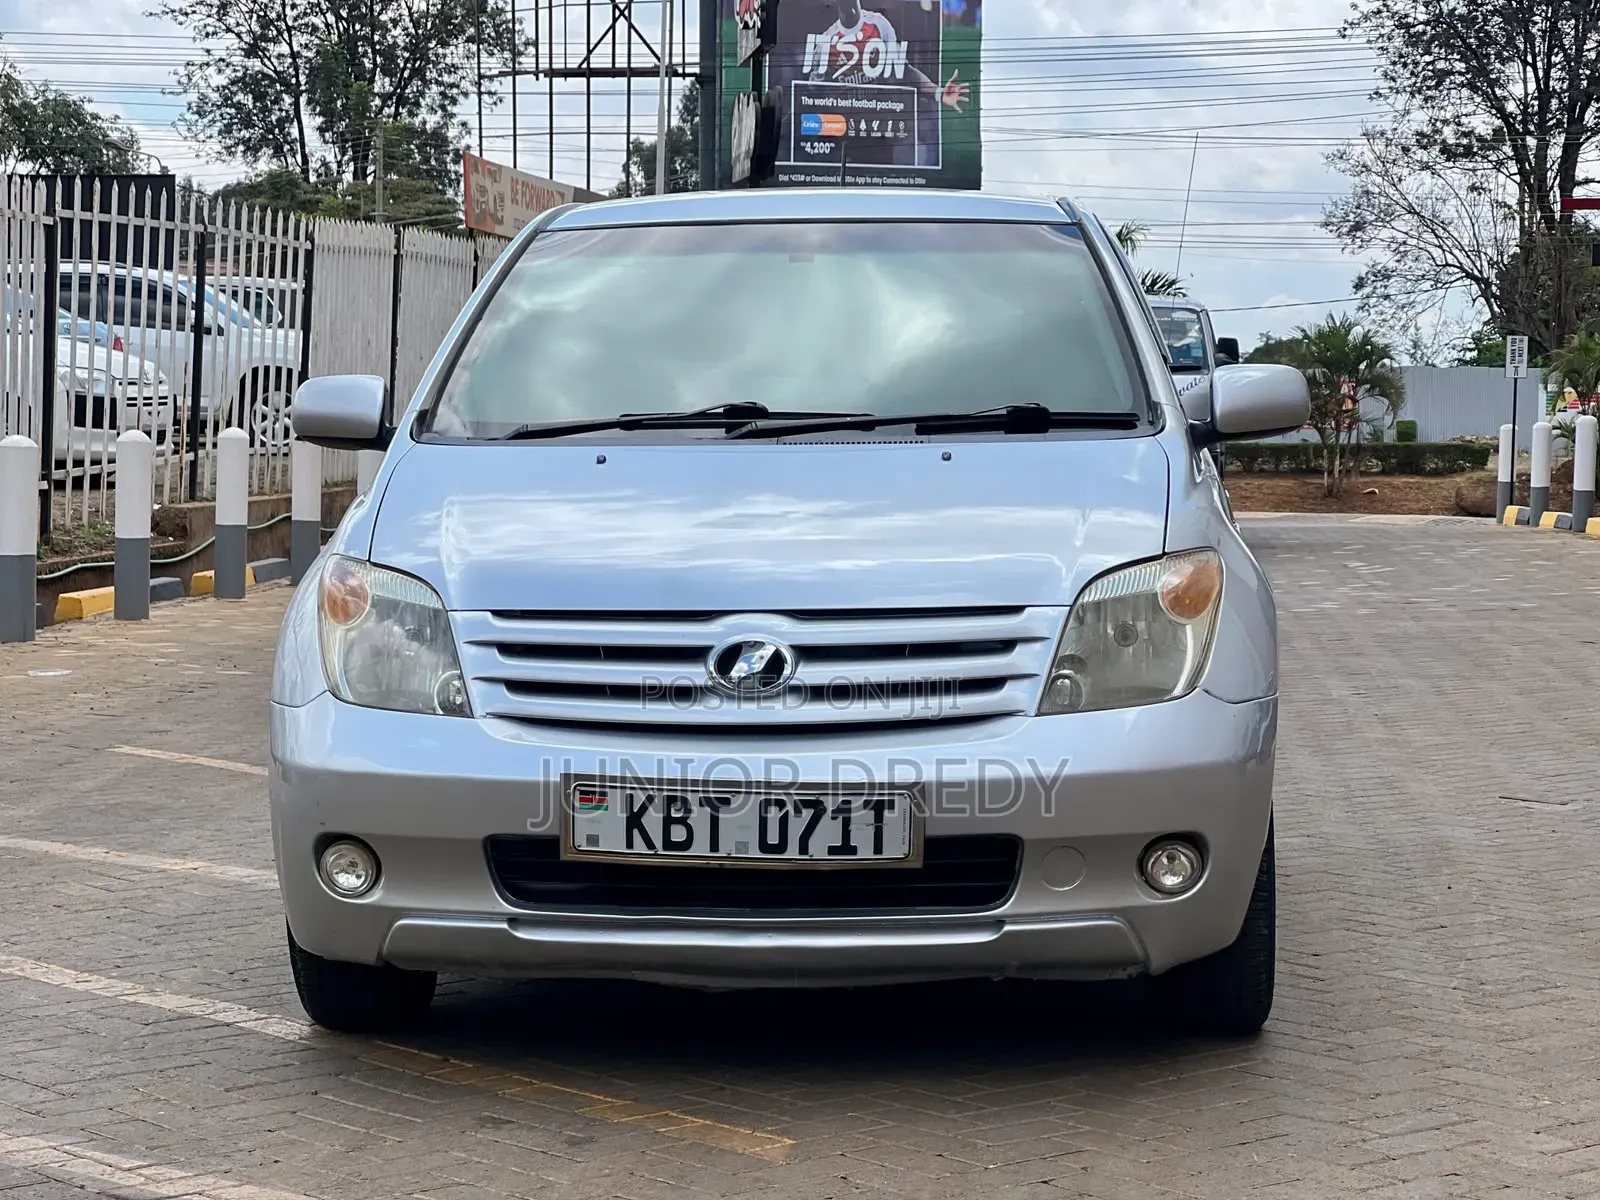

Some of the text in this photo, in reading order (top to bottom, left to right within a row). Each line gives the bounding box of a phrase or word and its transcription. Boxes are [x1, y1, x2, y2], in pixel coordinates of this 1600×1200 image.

[802, 33, 908, 79] IT'S ON
[801, 96, 904, 112] The world's best football package
[510, 175, 555, 212] BE FORWARD
[624, 792, 732, 853] KBT
